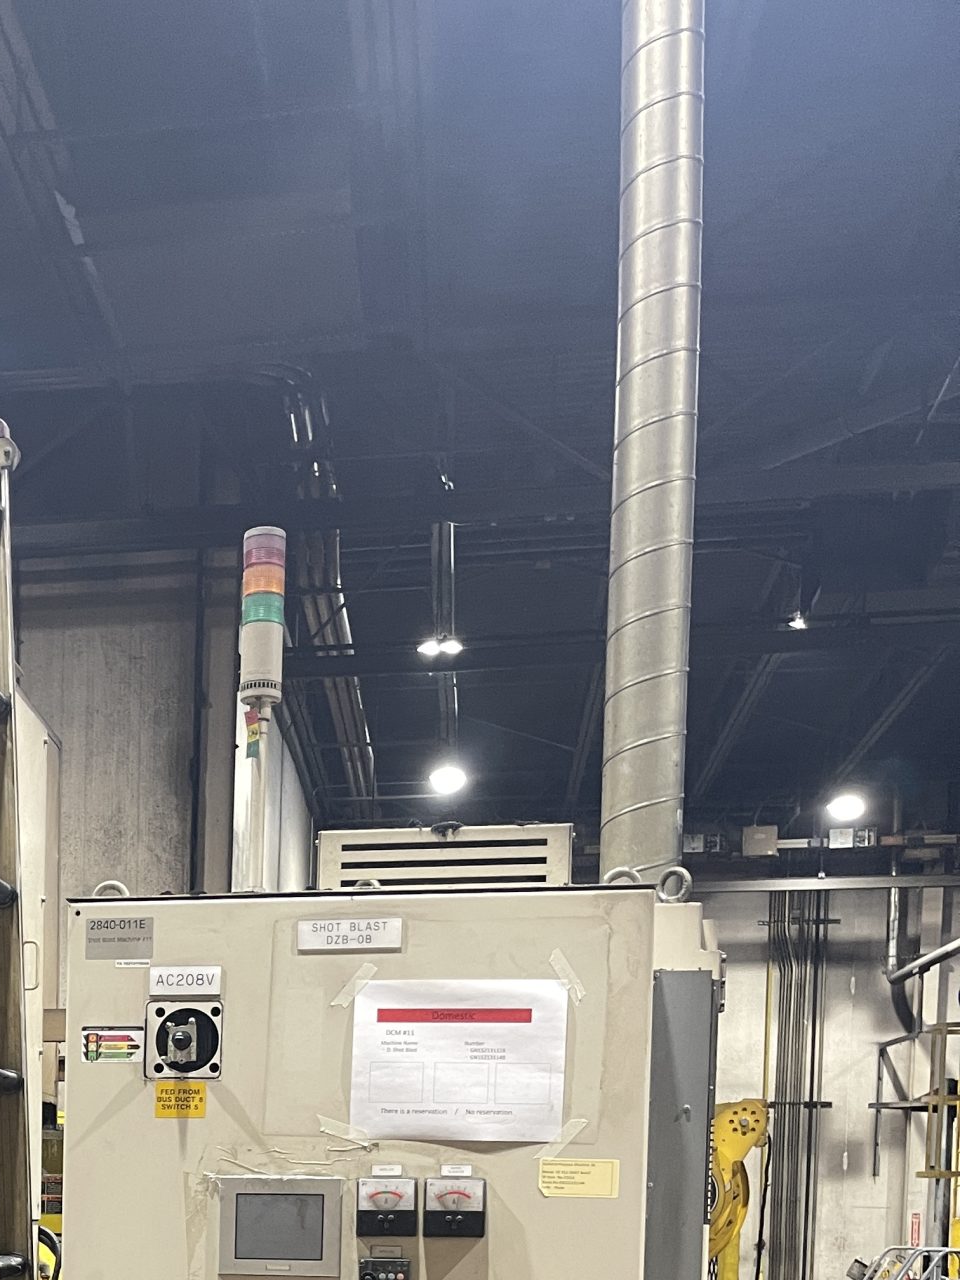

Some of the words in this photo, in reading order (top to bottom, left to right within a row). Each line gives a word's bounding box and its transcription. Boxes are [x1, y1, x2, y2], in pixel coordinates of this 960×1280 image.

[90, 919, 146, 930] 2840-011E
[311, 922, 341, 932] SHOT
[349, 921, 388, 931] BLAST
[155, 973, 215, 987] AC208V
[431, 1011, 477, 1020] Domestic
[161, 1103, 191, 1111] SWITCH
[380, 1107, 398, 1115] There
